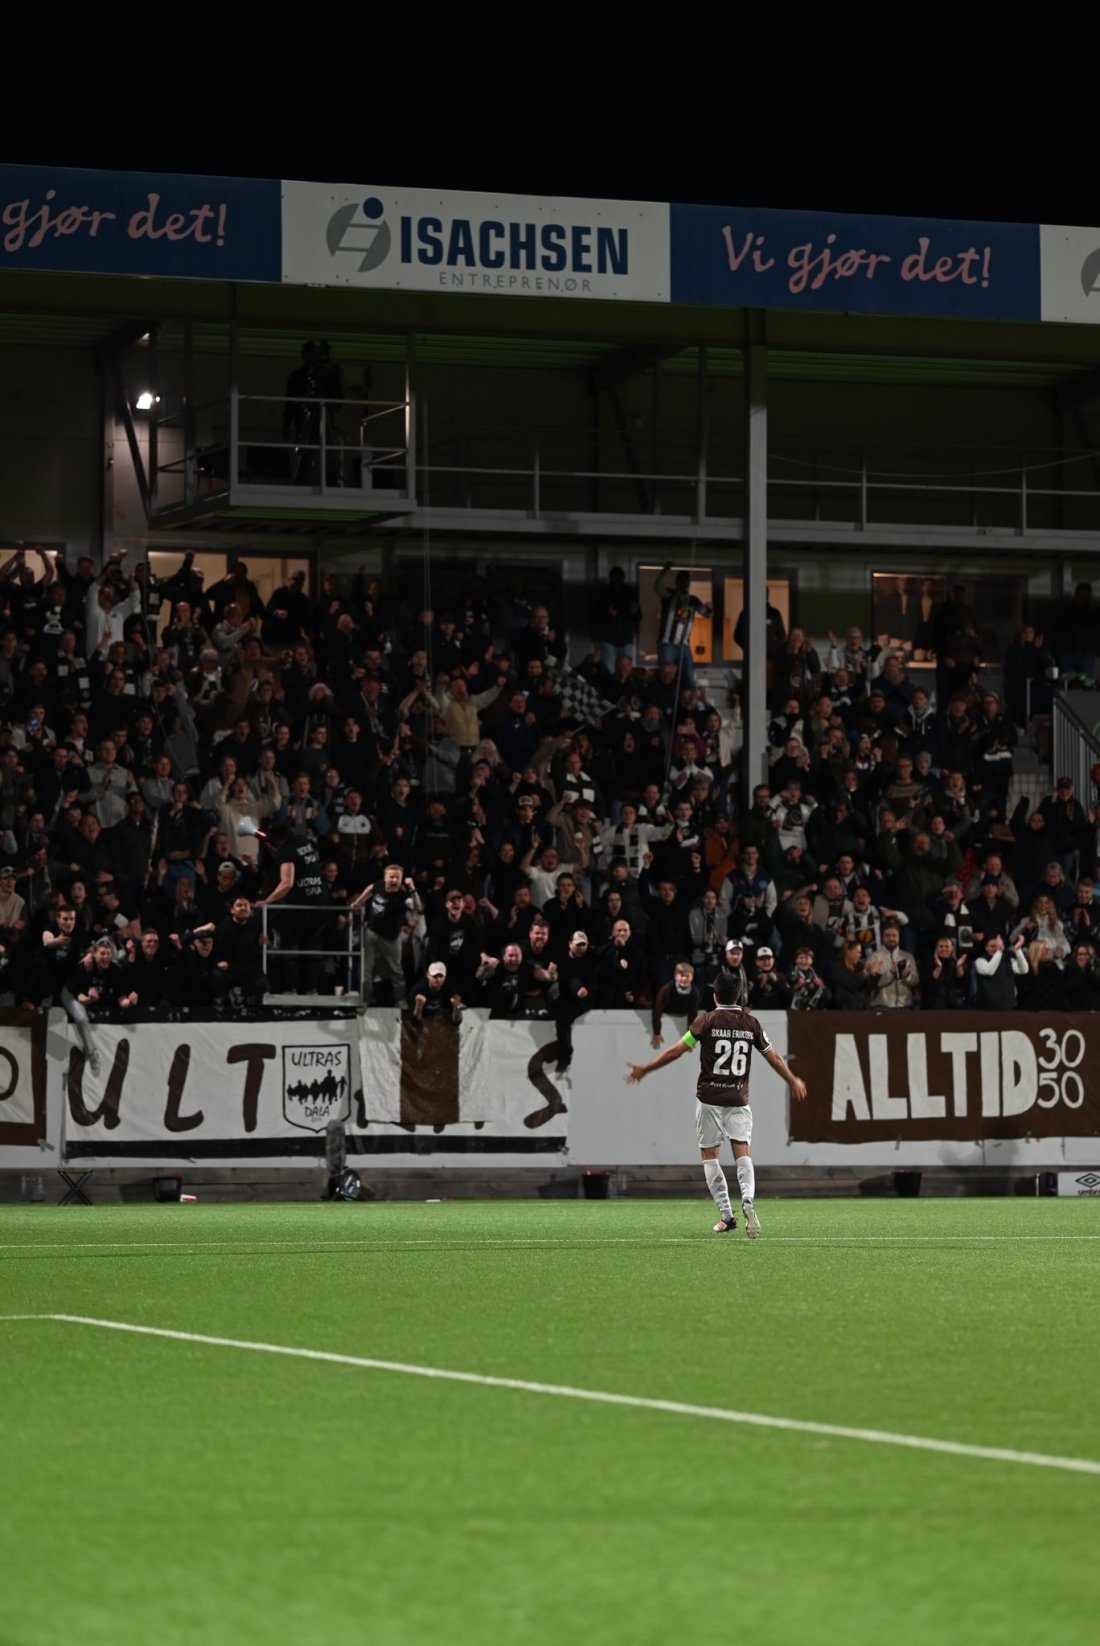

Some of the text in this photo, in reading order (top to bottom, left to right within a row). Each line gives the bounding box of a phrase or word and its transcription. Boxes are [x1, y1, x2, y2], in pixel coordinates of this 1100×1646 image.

[2, 190, 228, 253] gjør det!
[401, 216, 628, 275] ISACHSEN
[721, 225, 993, 295] Vi gjør det!
[439, 272, 592, 293] ENTREPRENØR
[711, 1028, 731, 1038] SKAAR
[1038, 1027, 1086, 1069] 30
[291, 1050, 342, 1067] ULTRAS
[712, 1039, 749, 1077] 26
[831, 1029, 1038, 1121] ALLTID
[1037, 1070, 1085, 1110] 50
[305, 1106, 329, 1117] DALA
